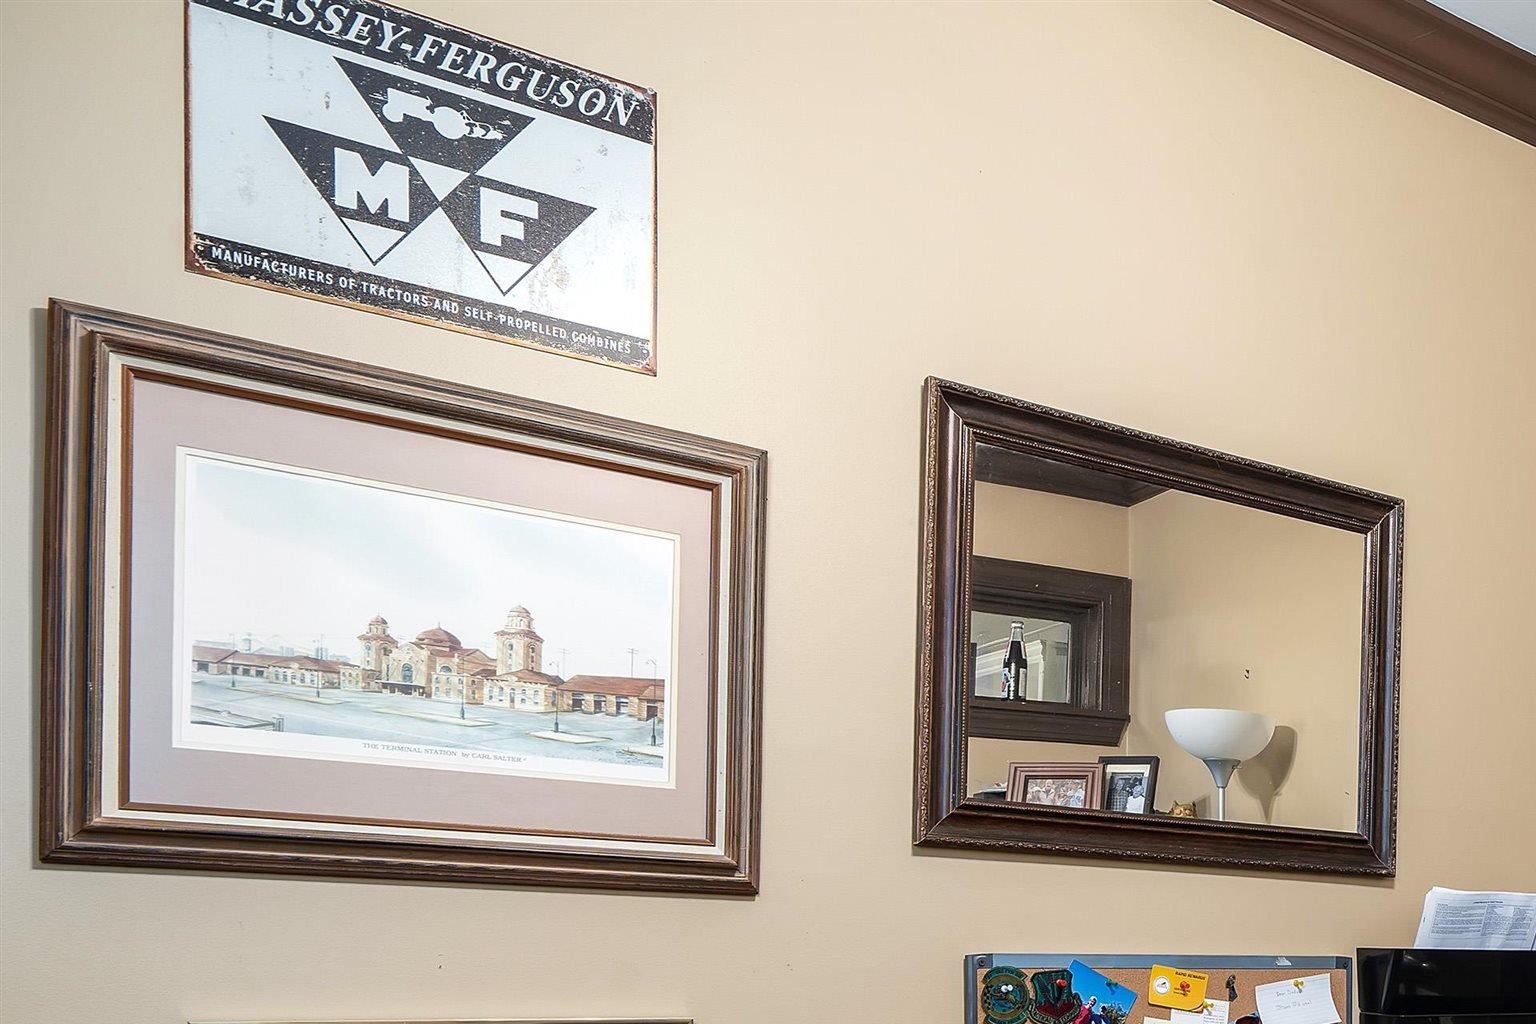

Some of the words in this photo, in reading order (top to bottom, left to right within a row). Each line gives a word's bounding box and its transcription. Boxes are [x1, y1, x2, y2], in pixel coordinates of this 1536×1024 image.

[225, 0, 639, 127] ASSEY-FERGUSON
[334, 147, 410, 223] M
[479, 186, 539, 247] F
[211, 246, 334, 285] MANUFACTURERS
[339, 276, 356, 290] OF
[361, 281, 430, 307] TRACTORS
[433, 298, 459, 315] AND
[464, 306, 567, 340] SELF-PROPELLED
[571, 330, 631, 354] COMBINES
[362, 742, 380, 750] THE
[381, 743, 422, 754] TERMINAL
[424, 748, 457, 757] STATION
[461, 751, 470, 759] by
[493, 755, 522, 763] SALTER
